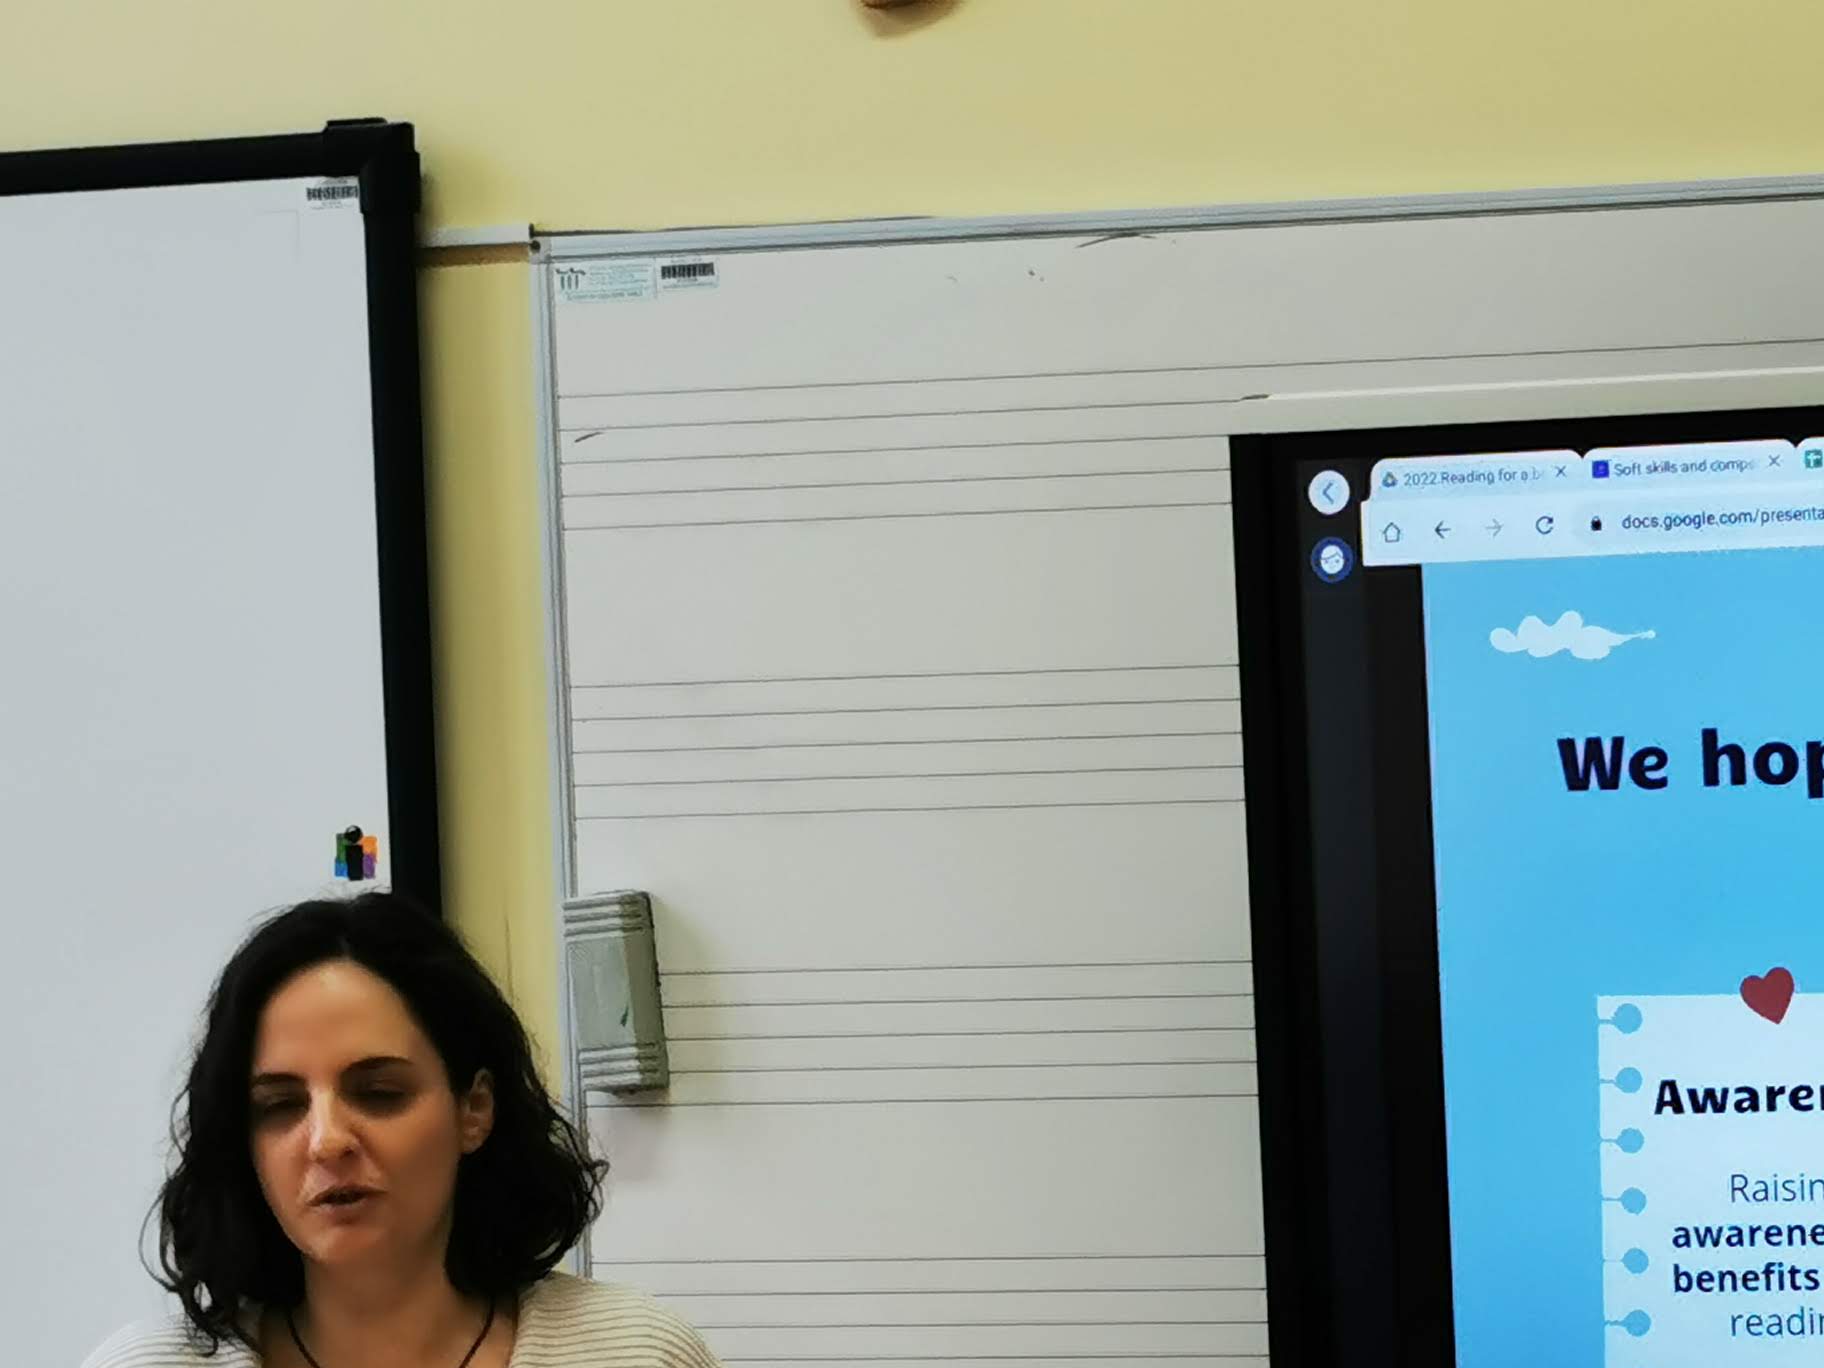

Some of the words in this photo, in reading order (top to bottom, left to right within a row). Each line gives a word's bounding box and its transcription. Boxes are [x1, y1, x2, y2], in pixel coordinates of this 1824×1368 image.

[1403, 472, 1438, 486] 2022
[1441, 469, 1495, 486] Reading
[1498, 467, 1518, 482] for
[1613, 462, 1642, 477] Soft
[1645, 460, 1679, 475] skills
[1680, 459, 1707, 473] and
[1556, 735, 1669, 792] We
[1672, 1262, 1820, 1293] benefits
